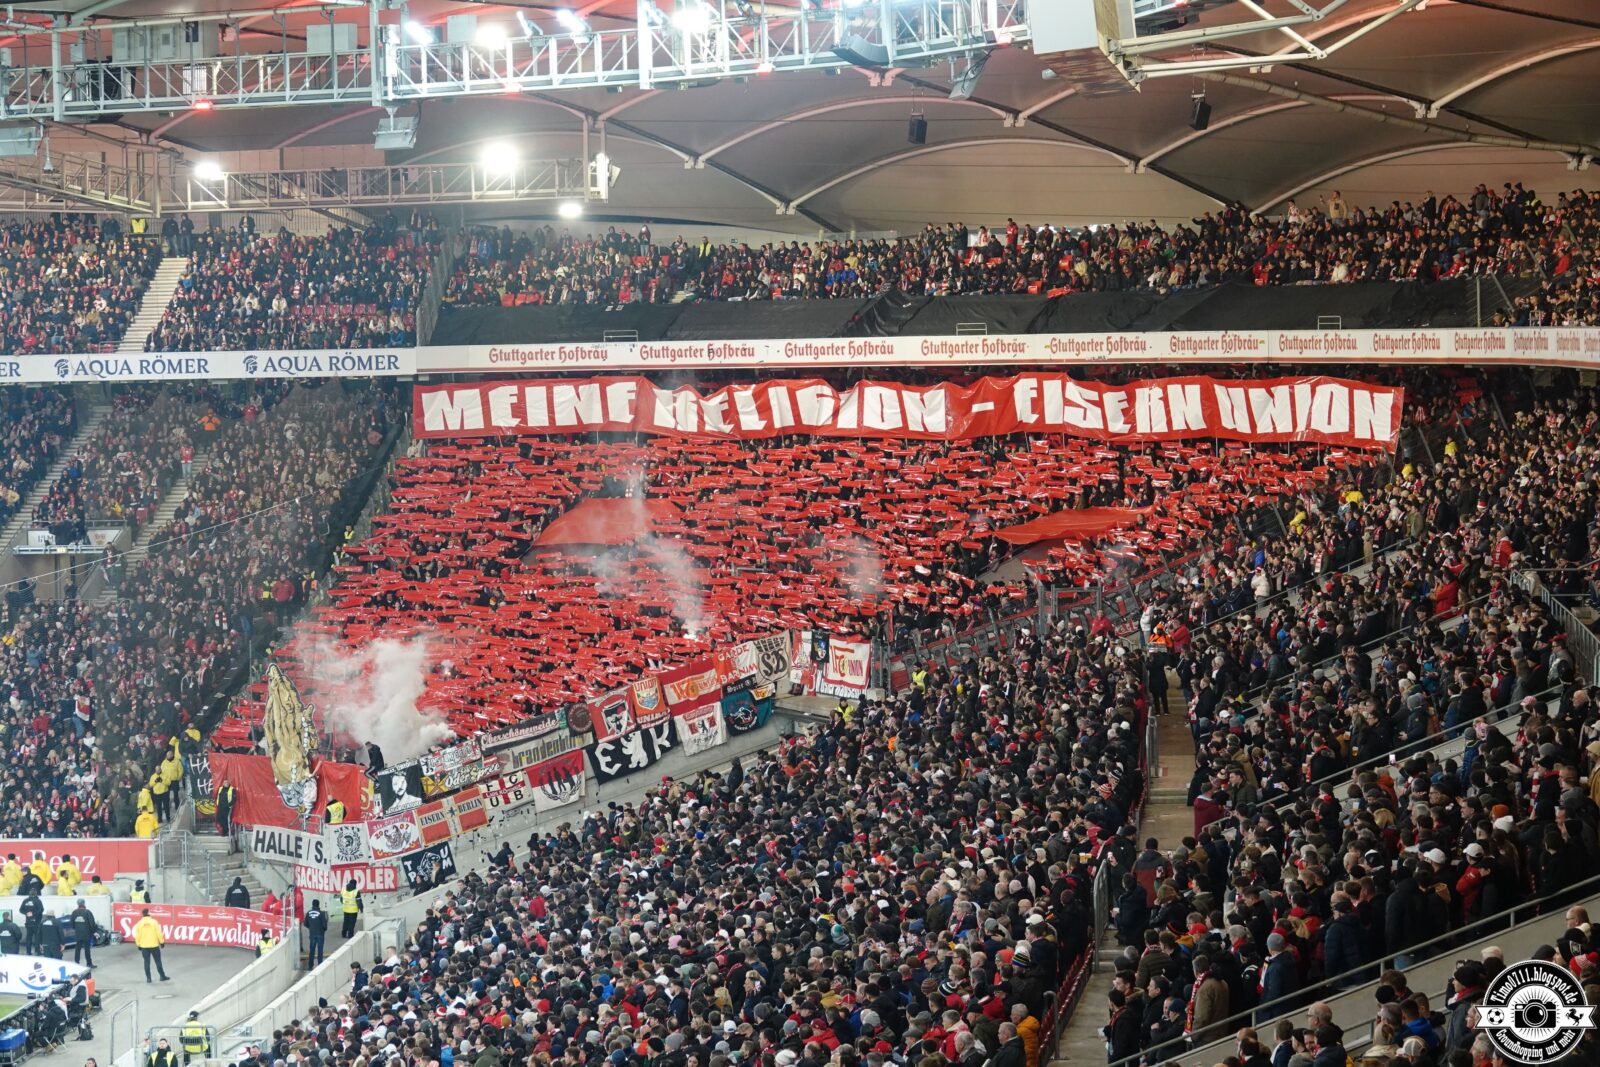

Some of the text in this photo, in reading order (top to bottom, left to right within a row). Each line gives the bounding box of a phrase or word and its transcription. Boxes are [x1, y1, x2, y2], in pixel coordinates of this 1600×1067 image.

[640, 344, 704, 362] Stuttgarter
[785, 341, 894, 360] Stuttgarter Hofbräu
[921, 340, 979, 357] Stuttgarter
[1050, 338, 1104, 356] Stuttgarter
[1279, 335, 1322, 354] Stuttgarter
[1373, 333, 1410, 354] Stuttgarter
[74, 355, 210, 378] AQUA RÖMER
[263, 352, 400, 375] AQUA RÖMER
[489, 348, 555, 364] Stuttgarter
[421, 381, 637, 431] MEINE
[652, 384, 945, 434] RELIGION
[1014, 378, 1207, 433] EISERN
[1213, 383, 1393, 440] UNION
[718, 644, 749, 661] GARDE
[720, 663, 758, 684] BARNIM
[420, 810, 446, 826] EISERN
[457, 798, 483, 813] BERLIN
[254, 830, 303, 859] HALLE
[0, 849, 96, 874] e-enz
